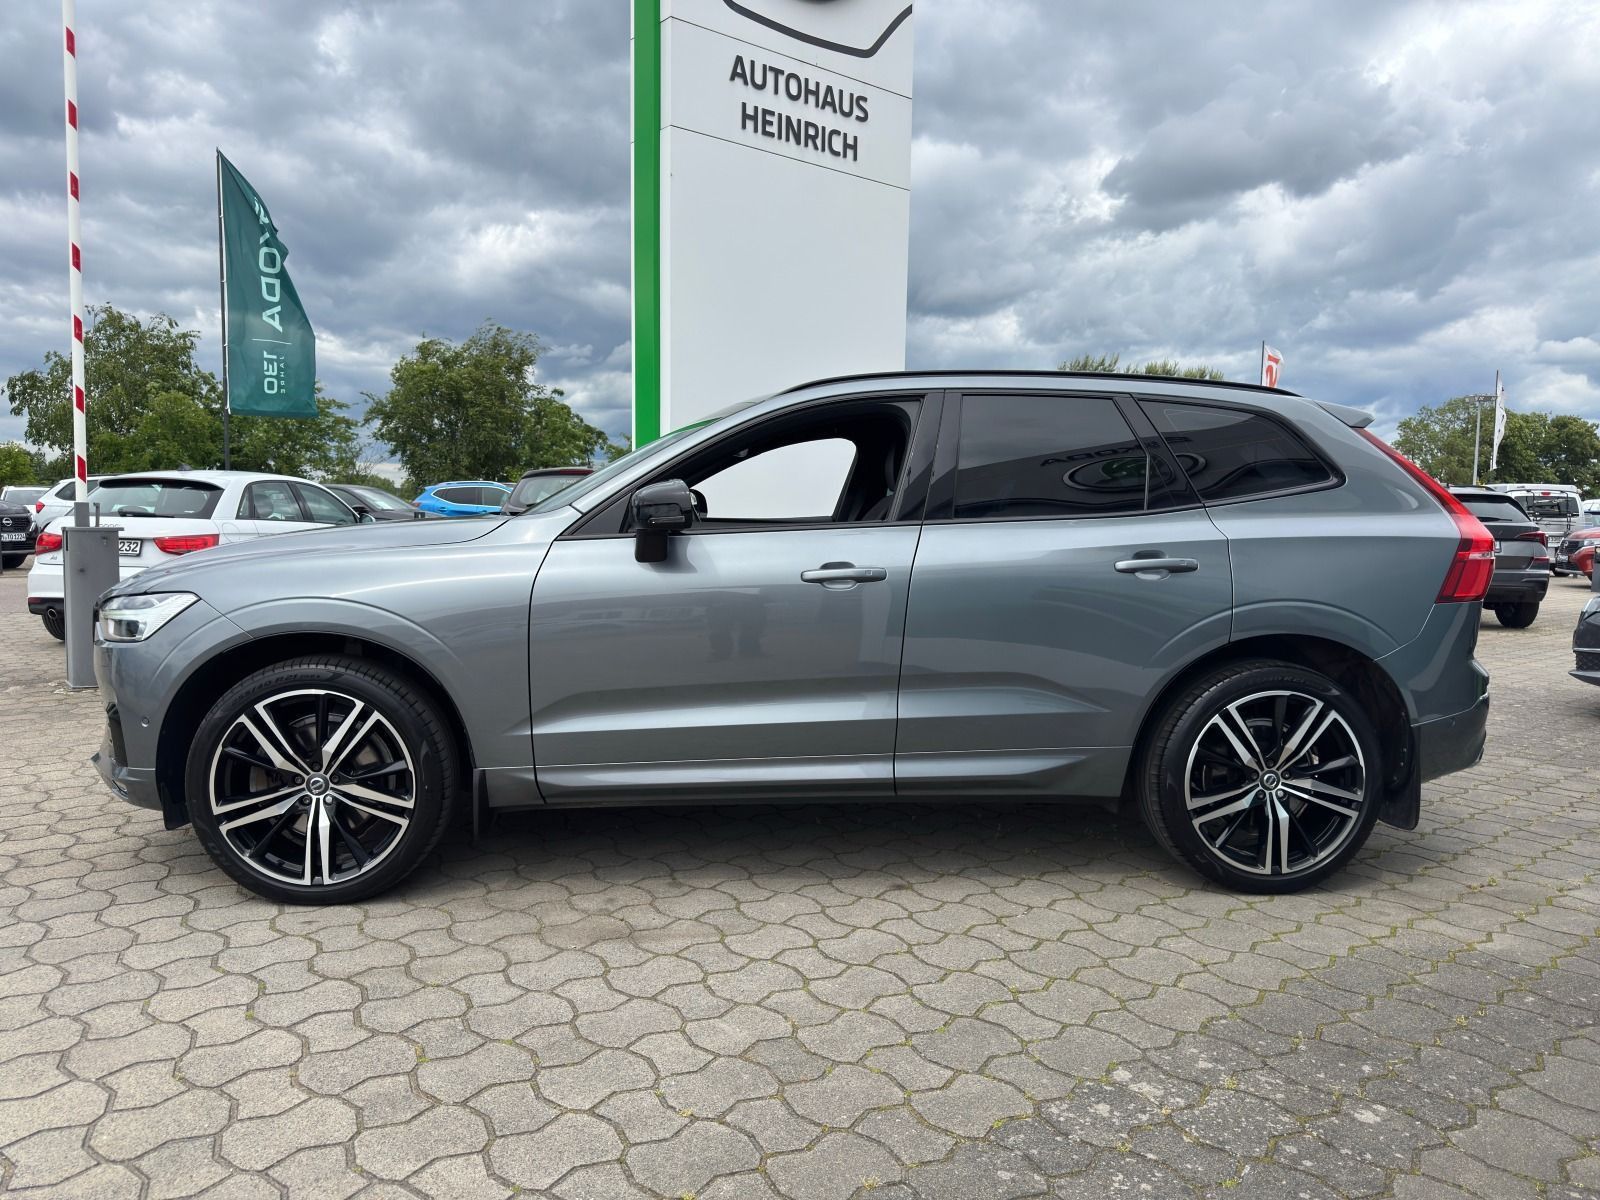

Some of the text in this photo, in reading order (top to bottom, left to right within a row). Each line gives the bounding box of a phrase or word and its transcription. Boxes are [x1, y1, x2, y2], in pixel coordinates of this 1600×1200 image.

[729, 54, 869, 123] AUTOHAUS
[741, 101, 858, 162] HEINRICH
[119, 541, 139, 553] 232
